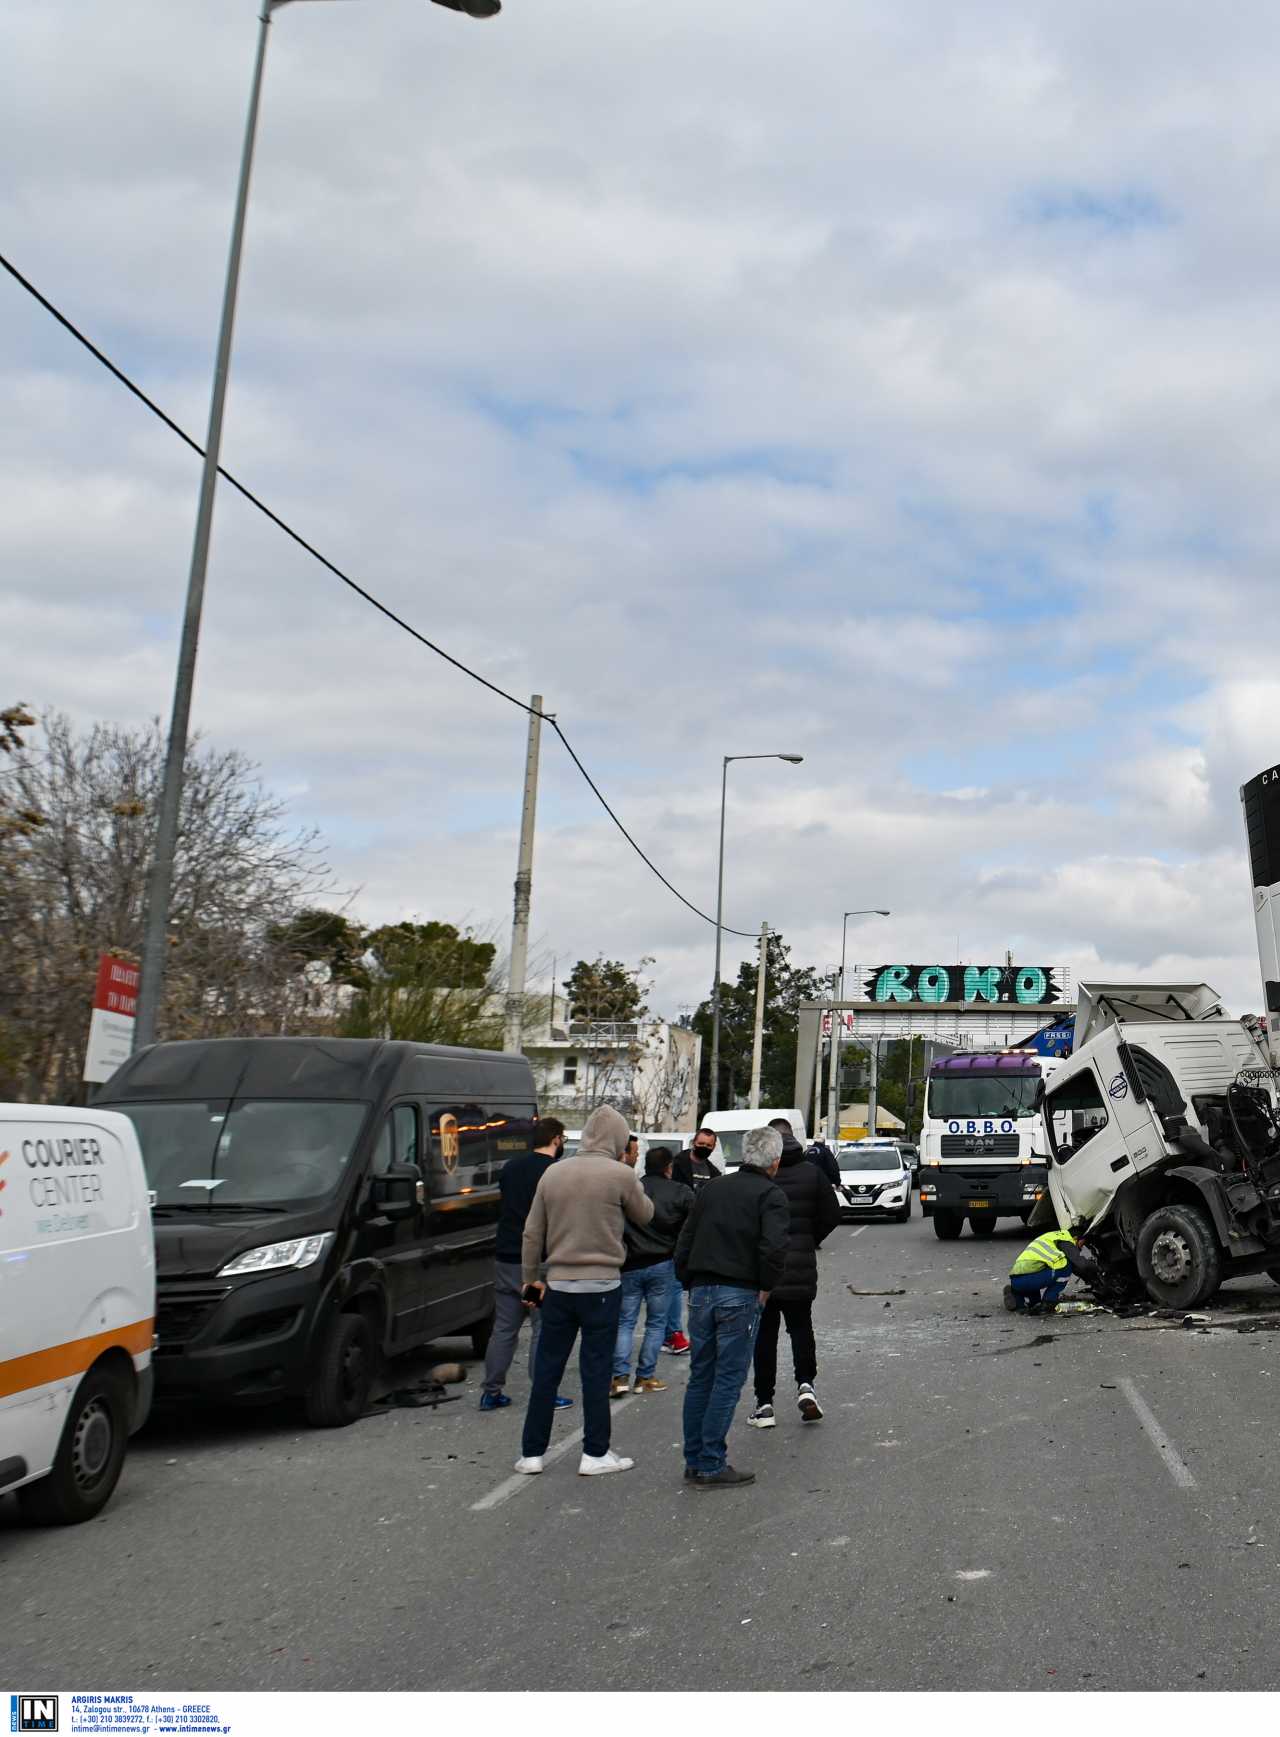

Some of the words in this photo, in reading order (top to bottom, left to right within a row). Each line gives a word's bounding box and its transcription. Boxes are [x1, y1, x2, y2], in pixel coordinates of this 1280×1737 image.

[948, 1120, 1017, 1134] O.B.B.O.
[22, 1138, 104, 1168] COURIER
[965, 1138, 995, 1146] MAN
[29, 1174, 104, 1207] CENTER
